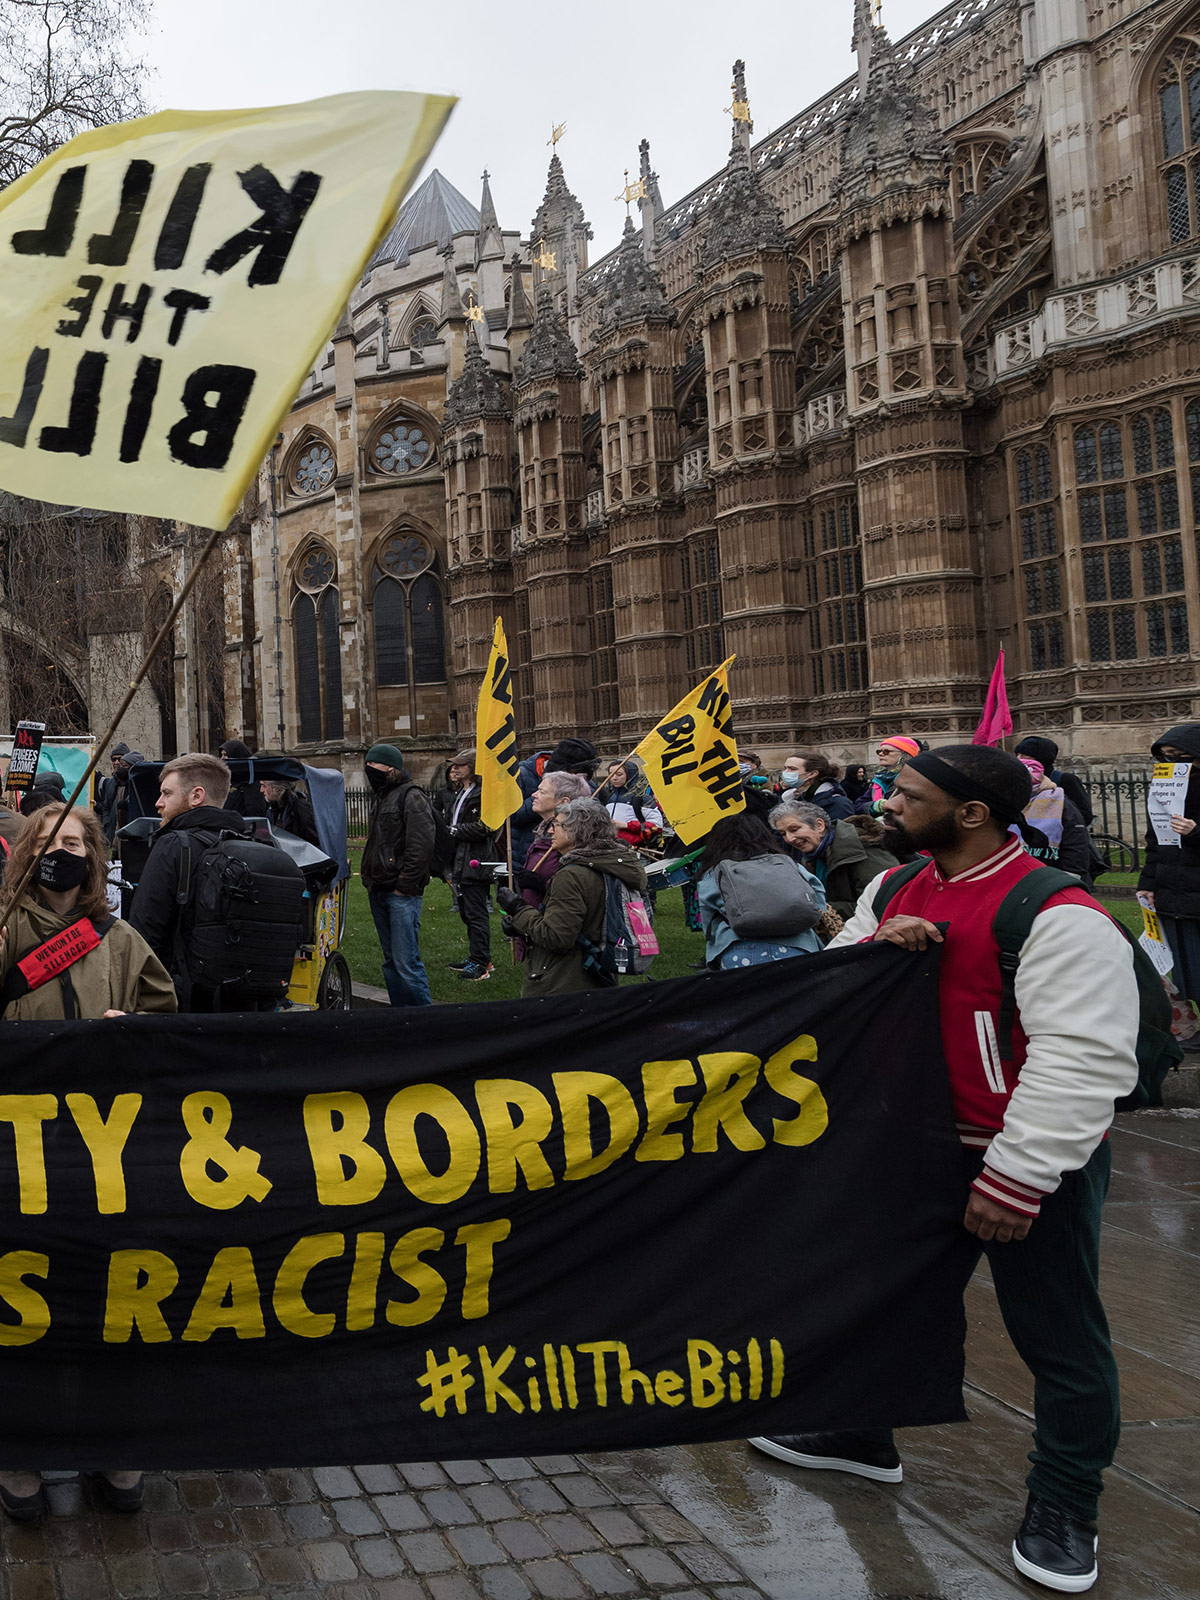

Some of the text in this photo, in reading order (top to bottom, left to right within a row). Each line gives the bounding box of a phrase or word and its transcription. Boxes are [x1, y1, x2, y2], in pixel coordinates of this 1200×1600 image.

[656, 714, 698, 786] BILL
[698, 739, 744, 811] THE
[44, 940, 86, 972] SILENCED
[70, 928, 82, 939] BE
[179, 1090, 272, 1210] &
[303, 1034, 829, 1206] BORDERS
[103, 1218, 511, 1344] RACIST
[416, 1336, 785, 1418] #KillTheBill
